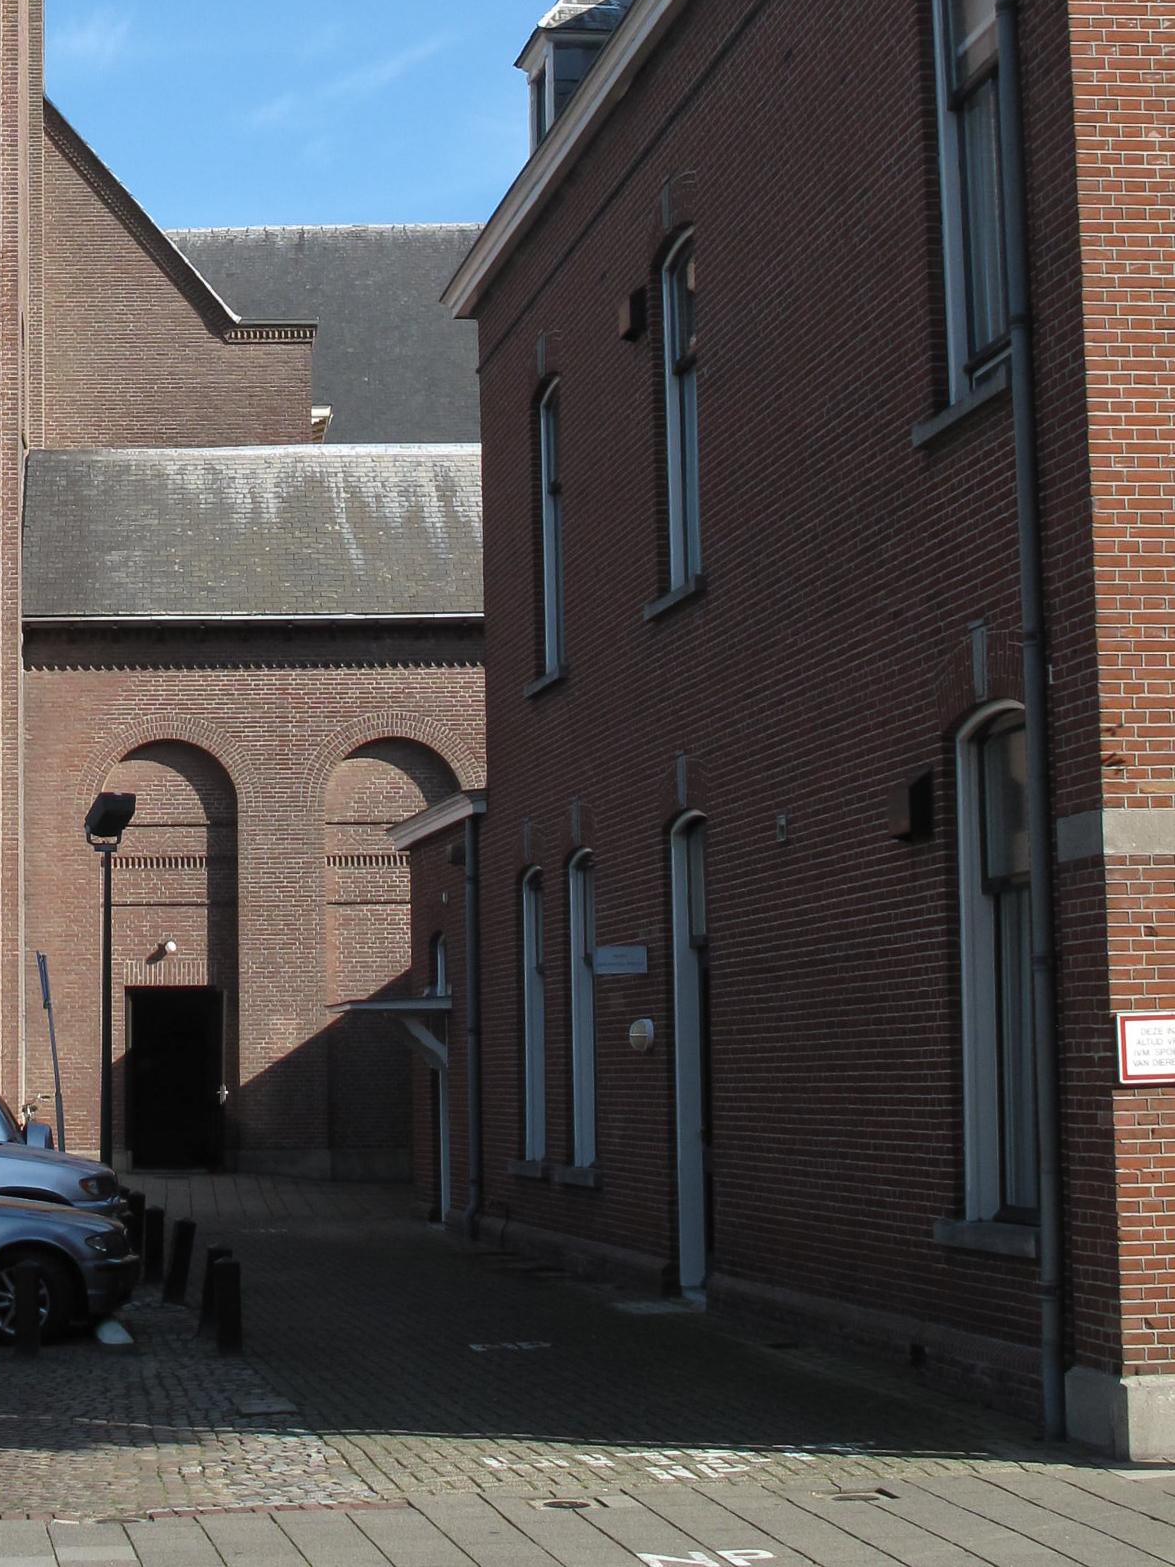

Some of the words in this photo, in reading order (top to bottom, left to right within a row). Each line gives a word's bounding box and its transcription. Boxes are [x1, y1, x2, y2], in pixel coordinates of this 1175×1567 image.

[1132, 1059, 1149, 1067] VAN
[644, 1463, 750, 1480] NP
[636, 1549, 775, 1567] NP
